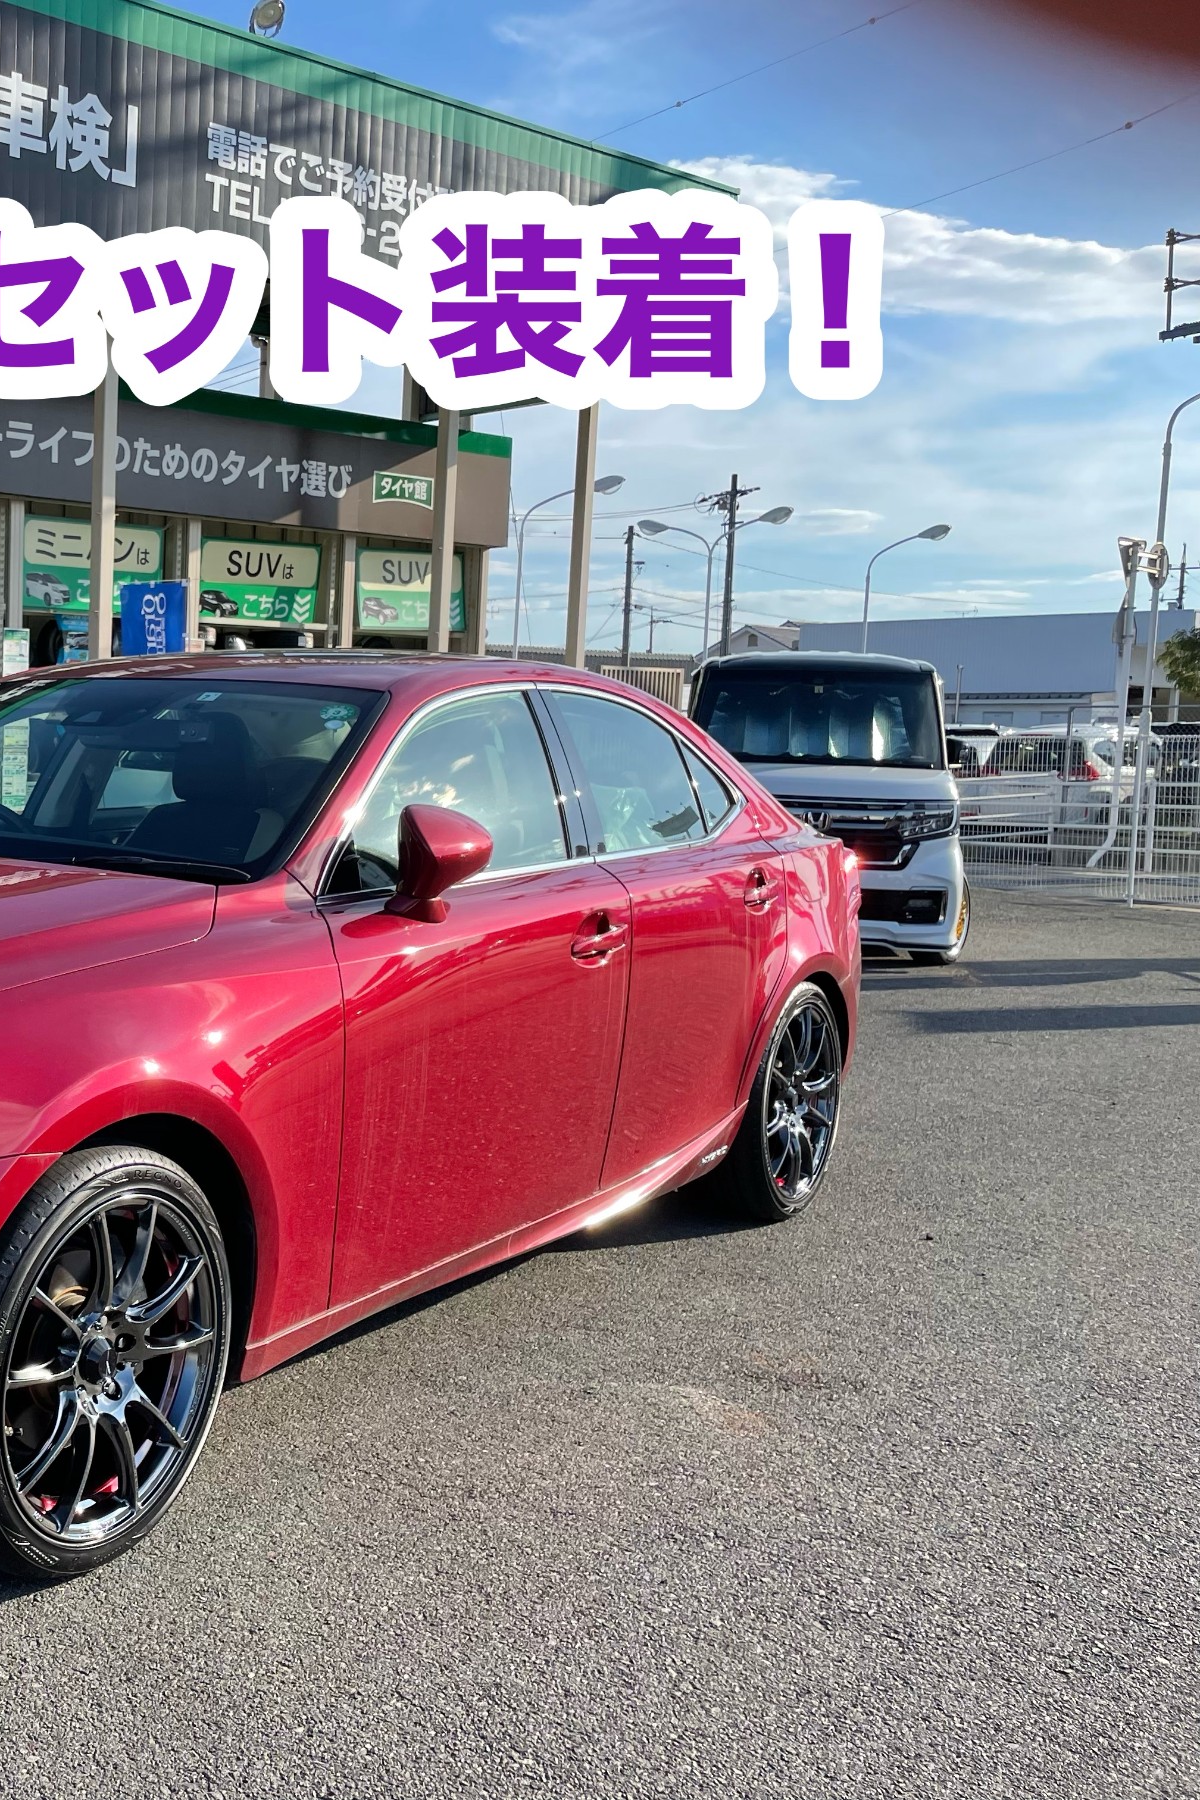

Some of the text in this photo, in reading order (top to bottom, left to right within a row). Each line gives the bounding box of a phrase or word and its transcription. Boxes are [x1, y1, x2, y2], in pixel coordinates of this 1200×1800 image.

[207, 121, 455, 216] 電話でご予約受付
[380, 476, 428, 501] タイヤ館
[35, 527, 151, 566] ミニンは
[242, 593, 290, 620] こちら
[133, 1169, 183, 1191] REGNO
